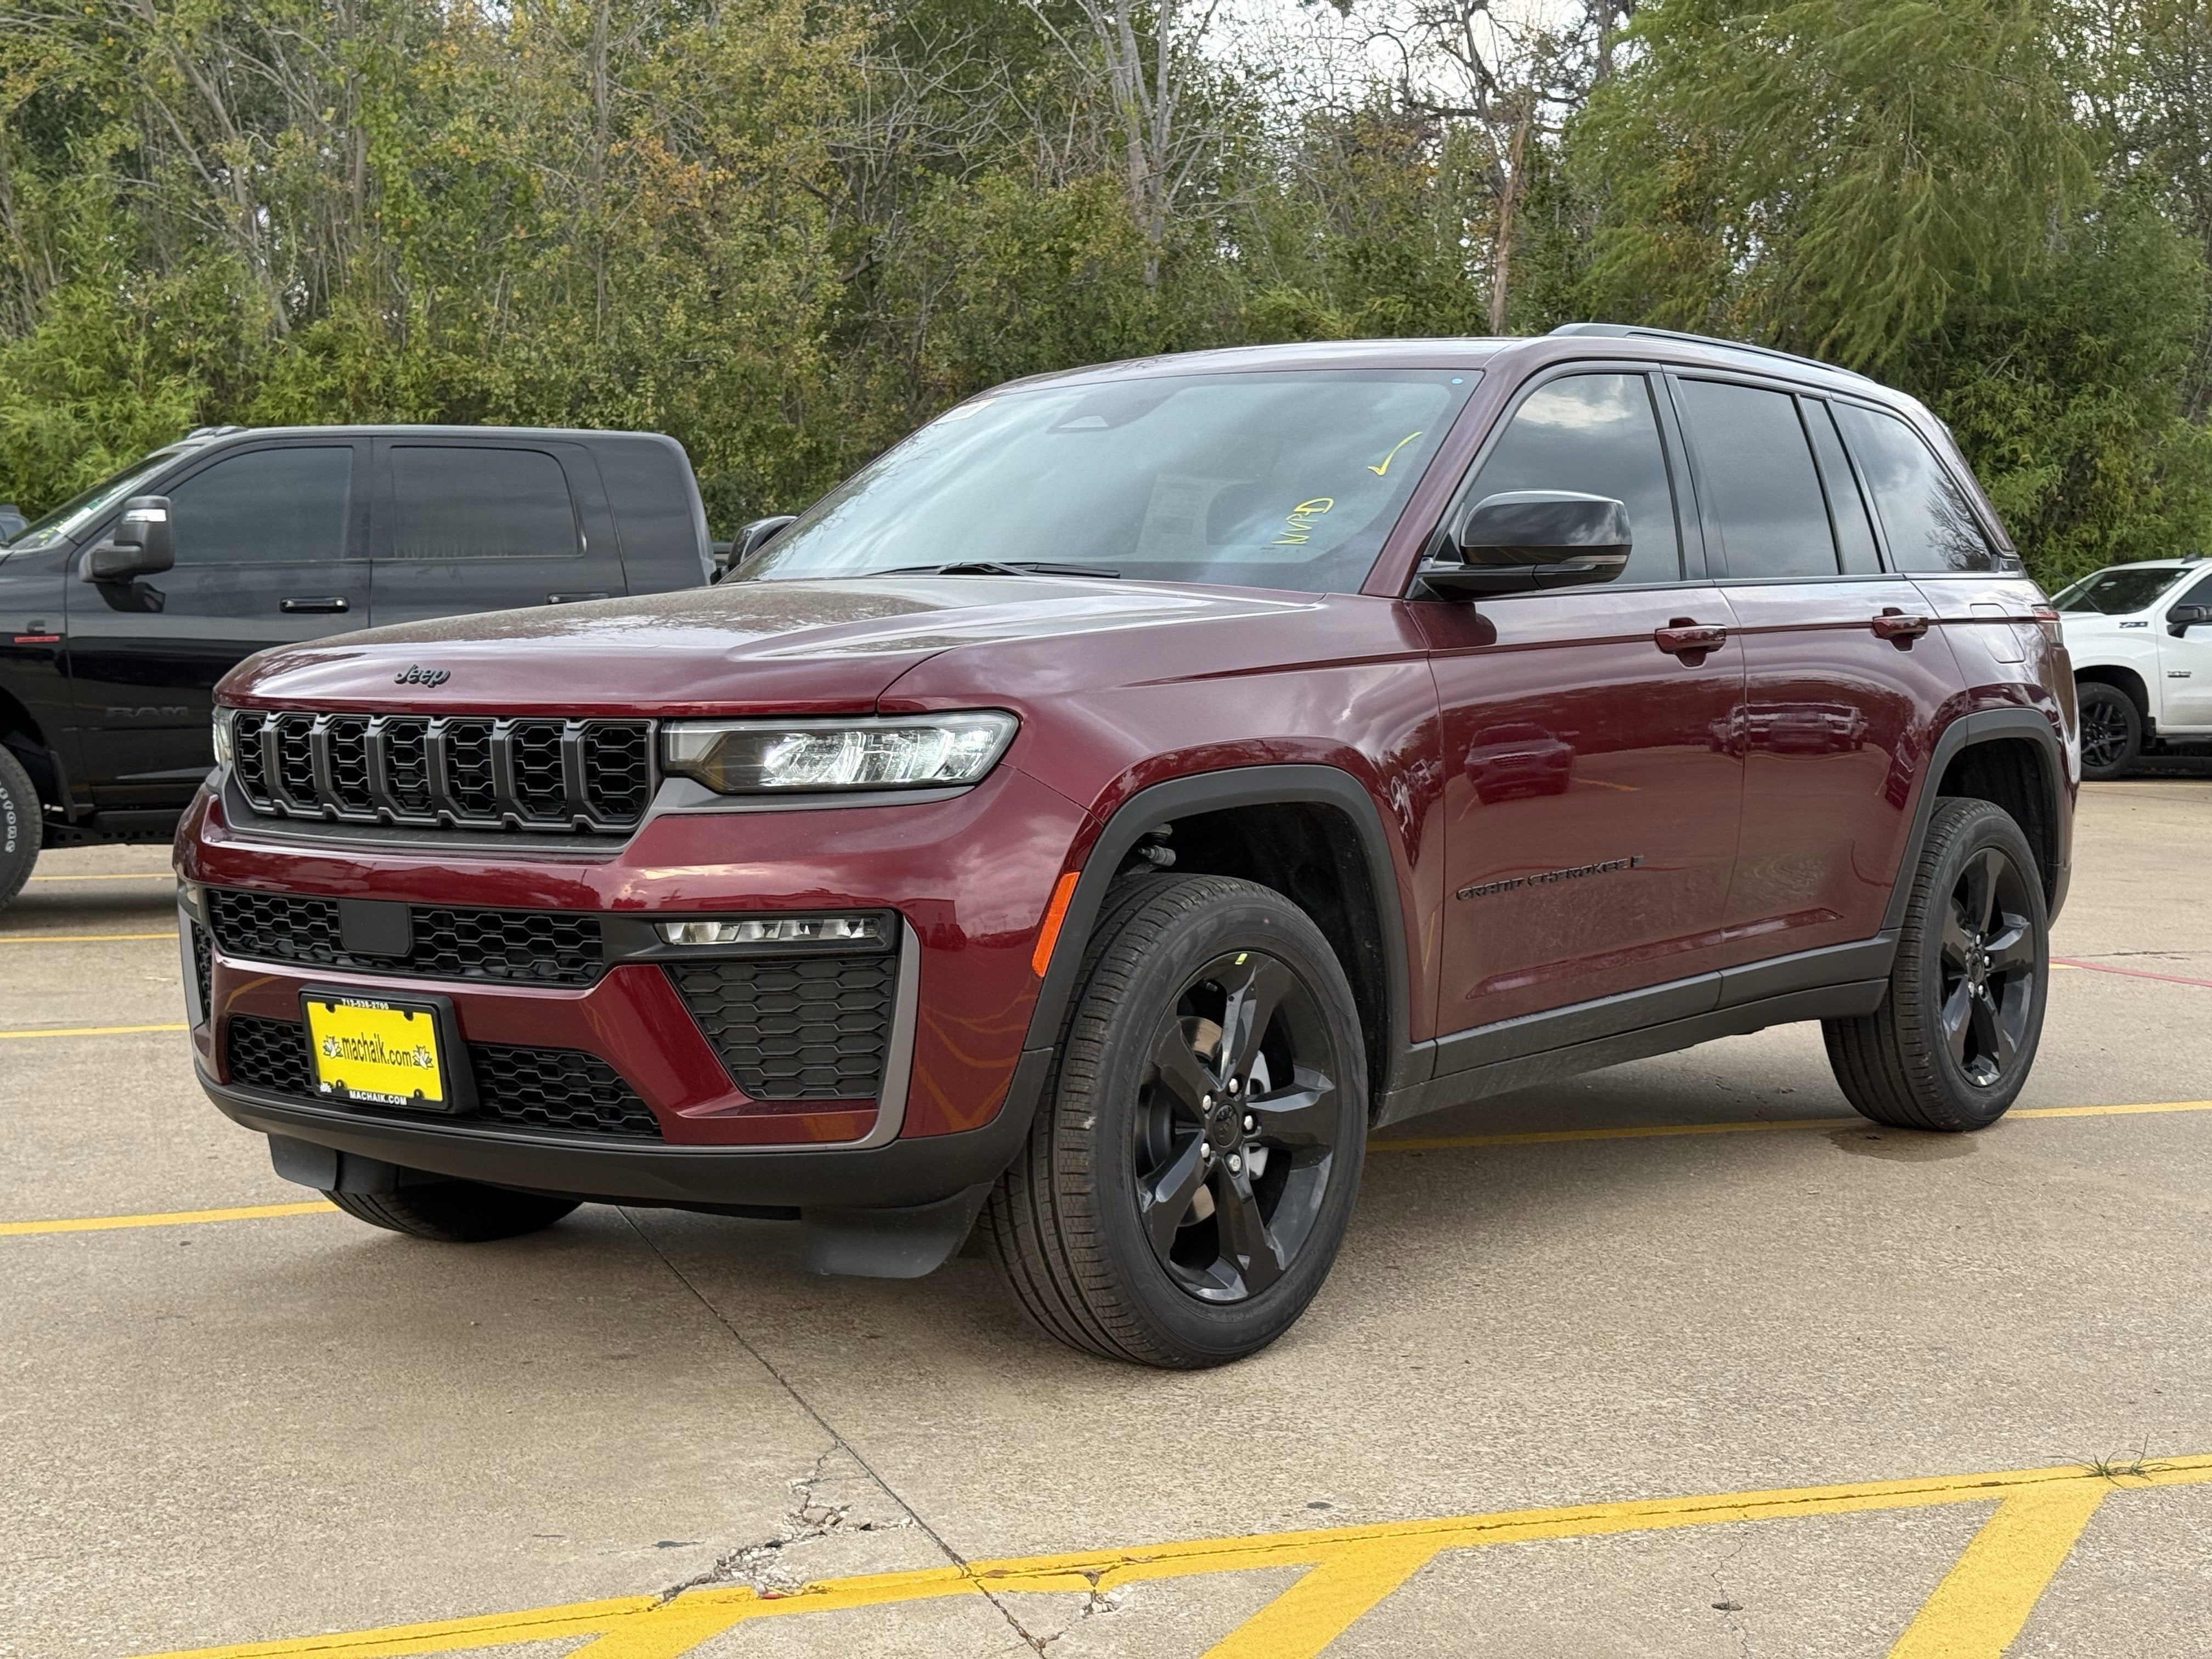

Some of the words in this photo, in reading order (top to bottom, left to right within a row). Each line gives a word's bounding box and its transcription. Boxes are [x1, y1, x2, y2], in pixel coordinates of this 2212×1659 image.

[394, 664, 451, 689] Jeep
[1527, 858, 1628, 887] CHEROKEE
[341, 1031, 413, 1067] machaik.com
[349, 1090, 408, 1106] MACHAIK.COM
